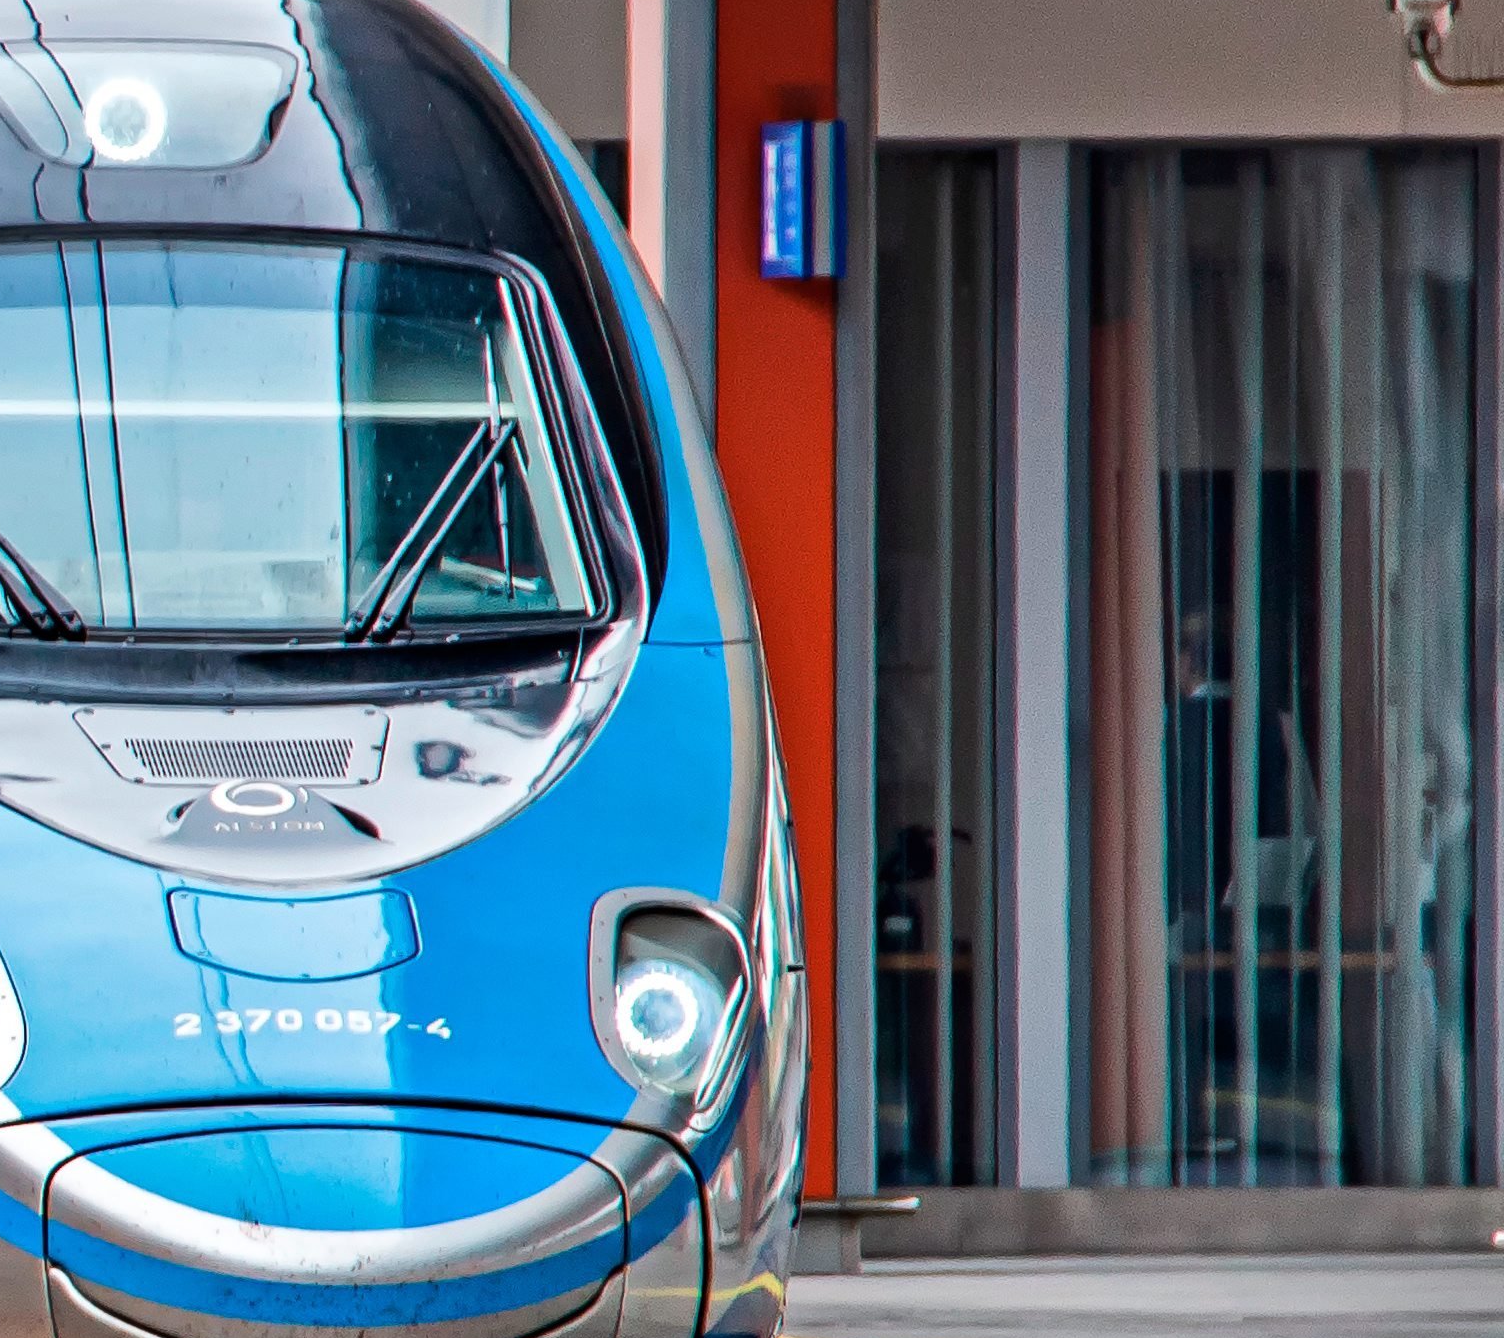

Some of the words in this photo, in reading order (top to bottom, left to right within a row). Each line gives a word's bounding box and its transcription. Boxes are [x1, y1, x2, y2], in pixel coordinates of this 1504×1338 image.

[174, 1012, 202, 1037] 2
[216, 1008, 303, 1033] 370
[315, 1008, 452, 1040] 057-4
